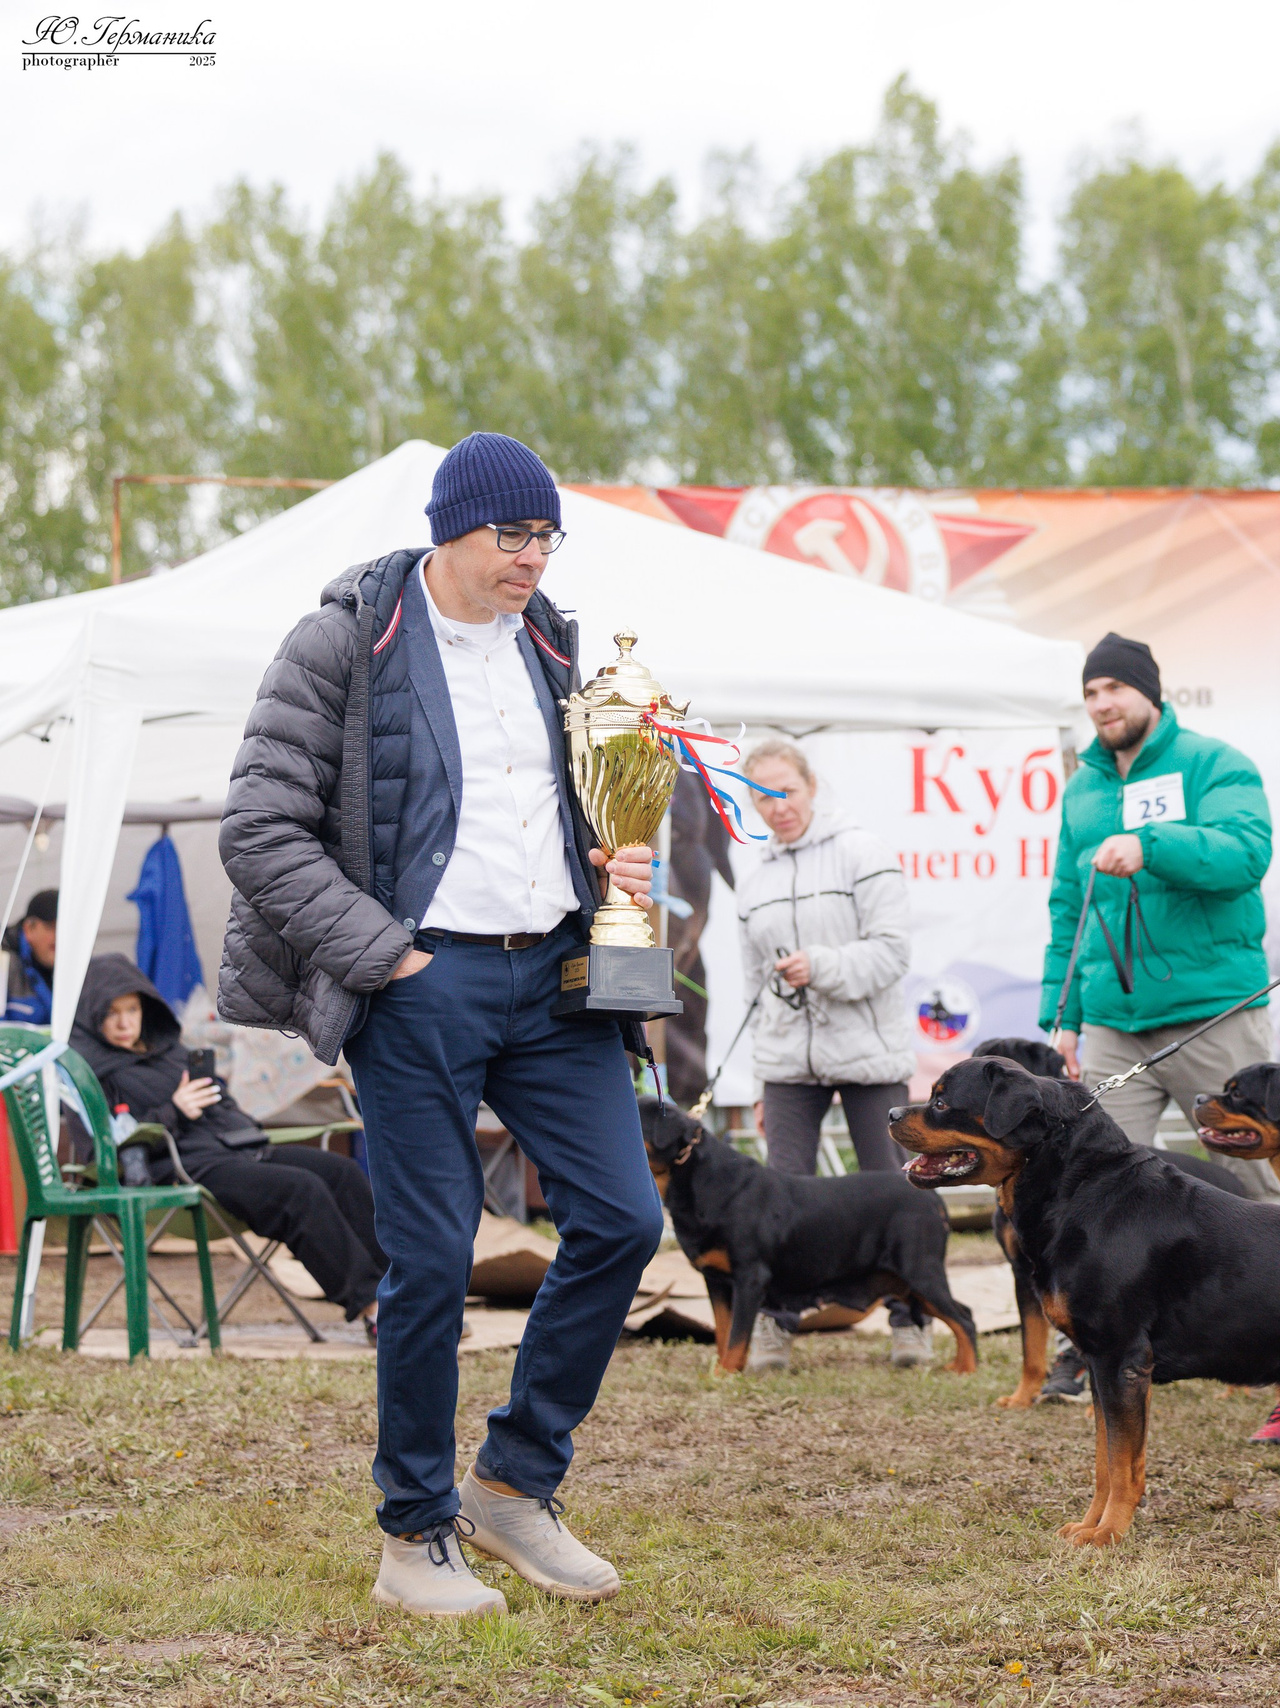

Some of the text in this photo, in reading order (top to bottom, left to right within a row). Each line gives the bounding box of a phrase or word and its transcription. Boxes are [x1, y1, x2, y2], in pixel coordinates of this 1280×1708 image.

[907, 747, 1058, 836] Куб
[1138, 796, 1167, 820] 25
[1017, 838, 1052, 878] Н
